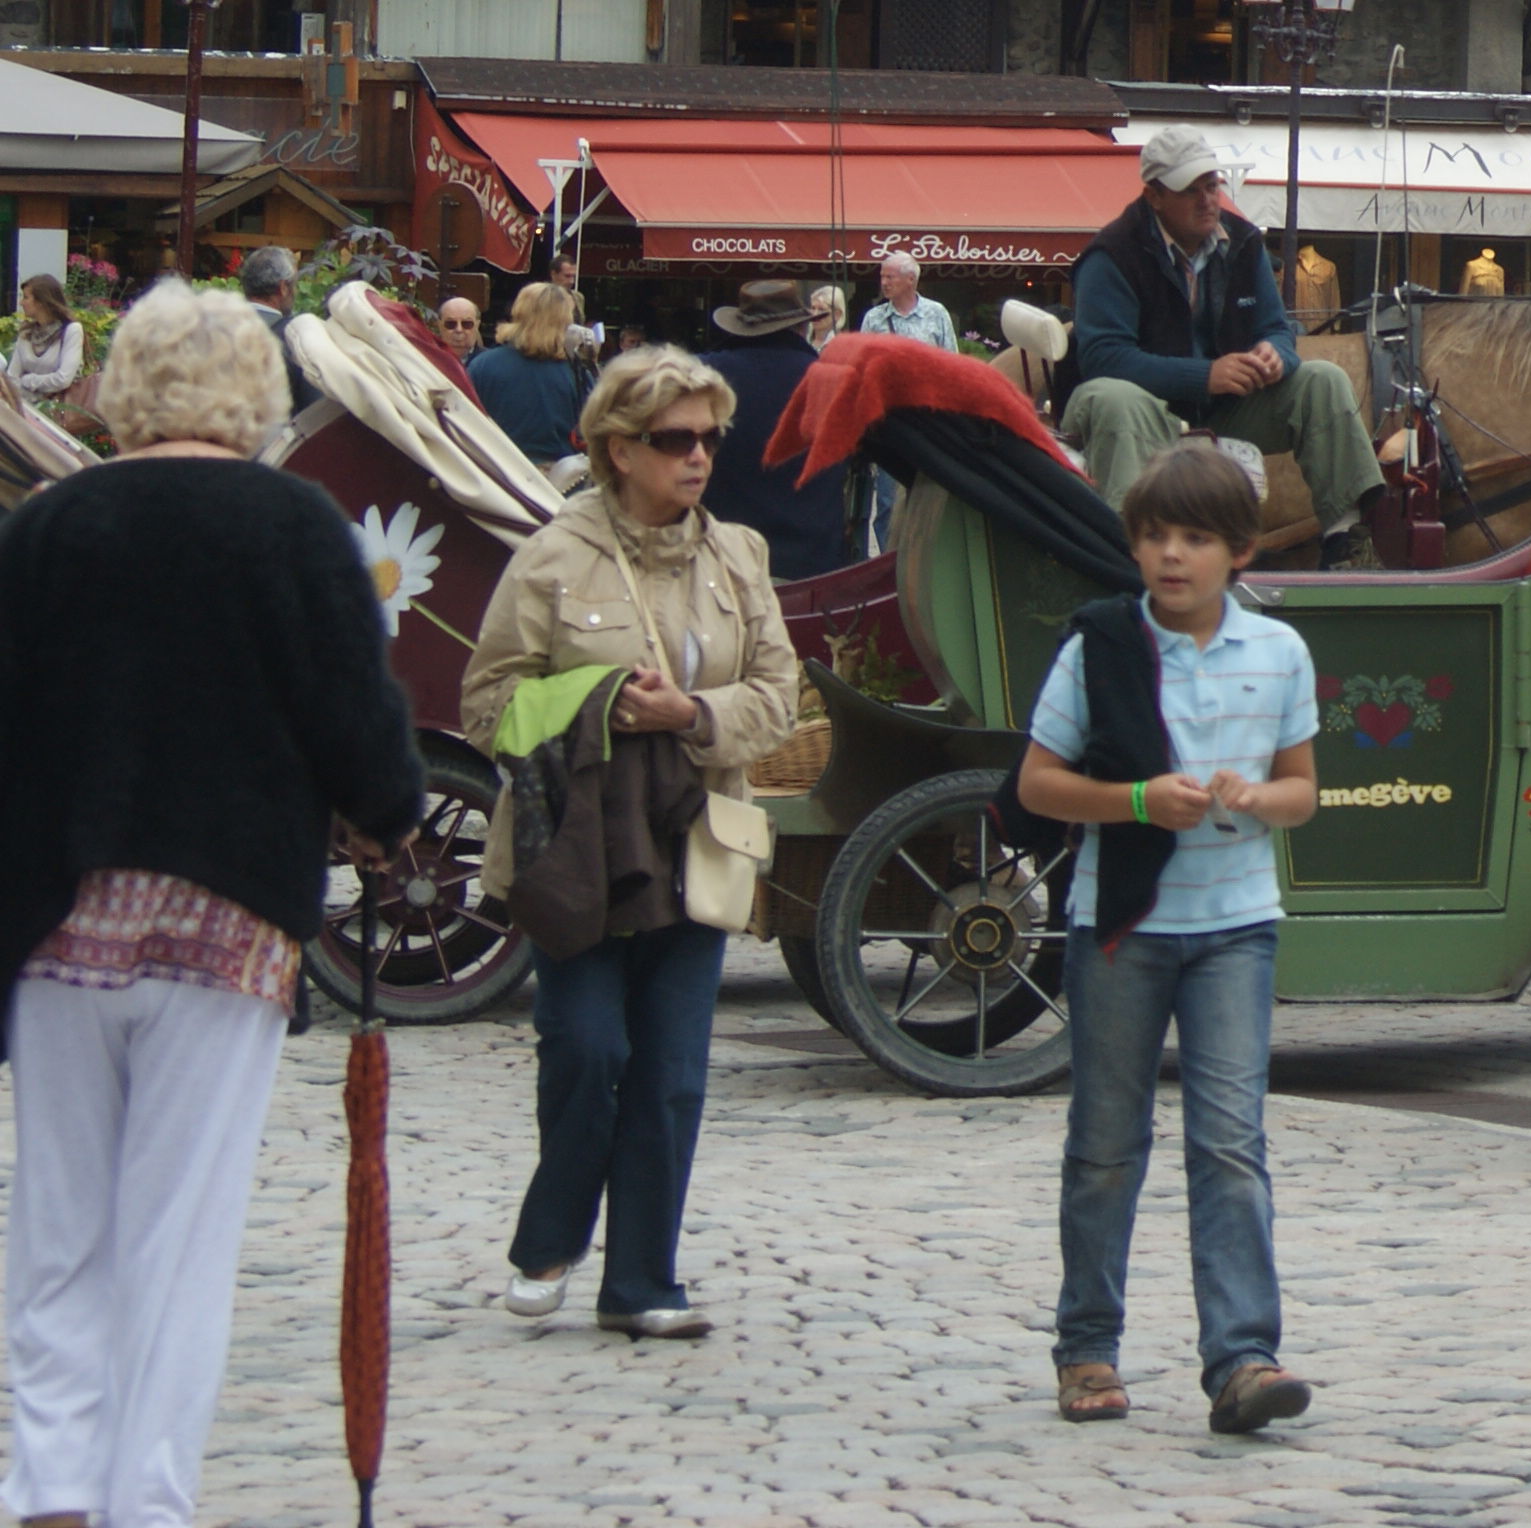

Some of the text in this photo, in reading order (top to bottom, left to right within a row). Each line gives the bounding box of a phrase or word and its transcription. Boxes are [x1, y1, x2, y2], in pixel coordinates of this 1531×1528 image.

[1213, 143, 1401, 163] venue
[692, 238, 787, 253] CHOCOLATS
[870, 233, 1046, 263] L'Arboisier
[605, 258, 670, 272] GLACIER
[1318, 777, 1453, 807] megève
